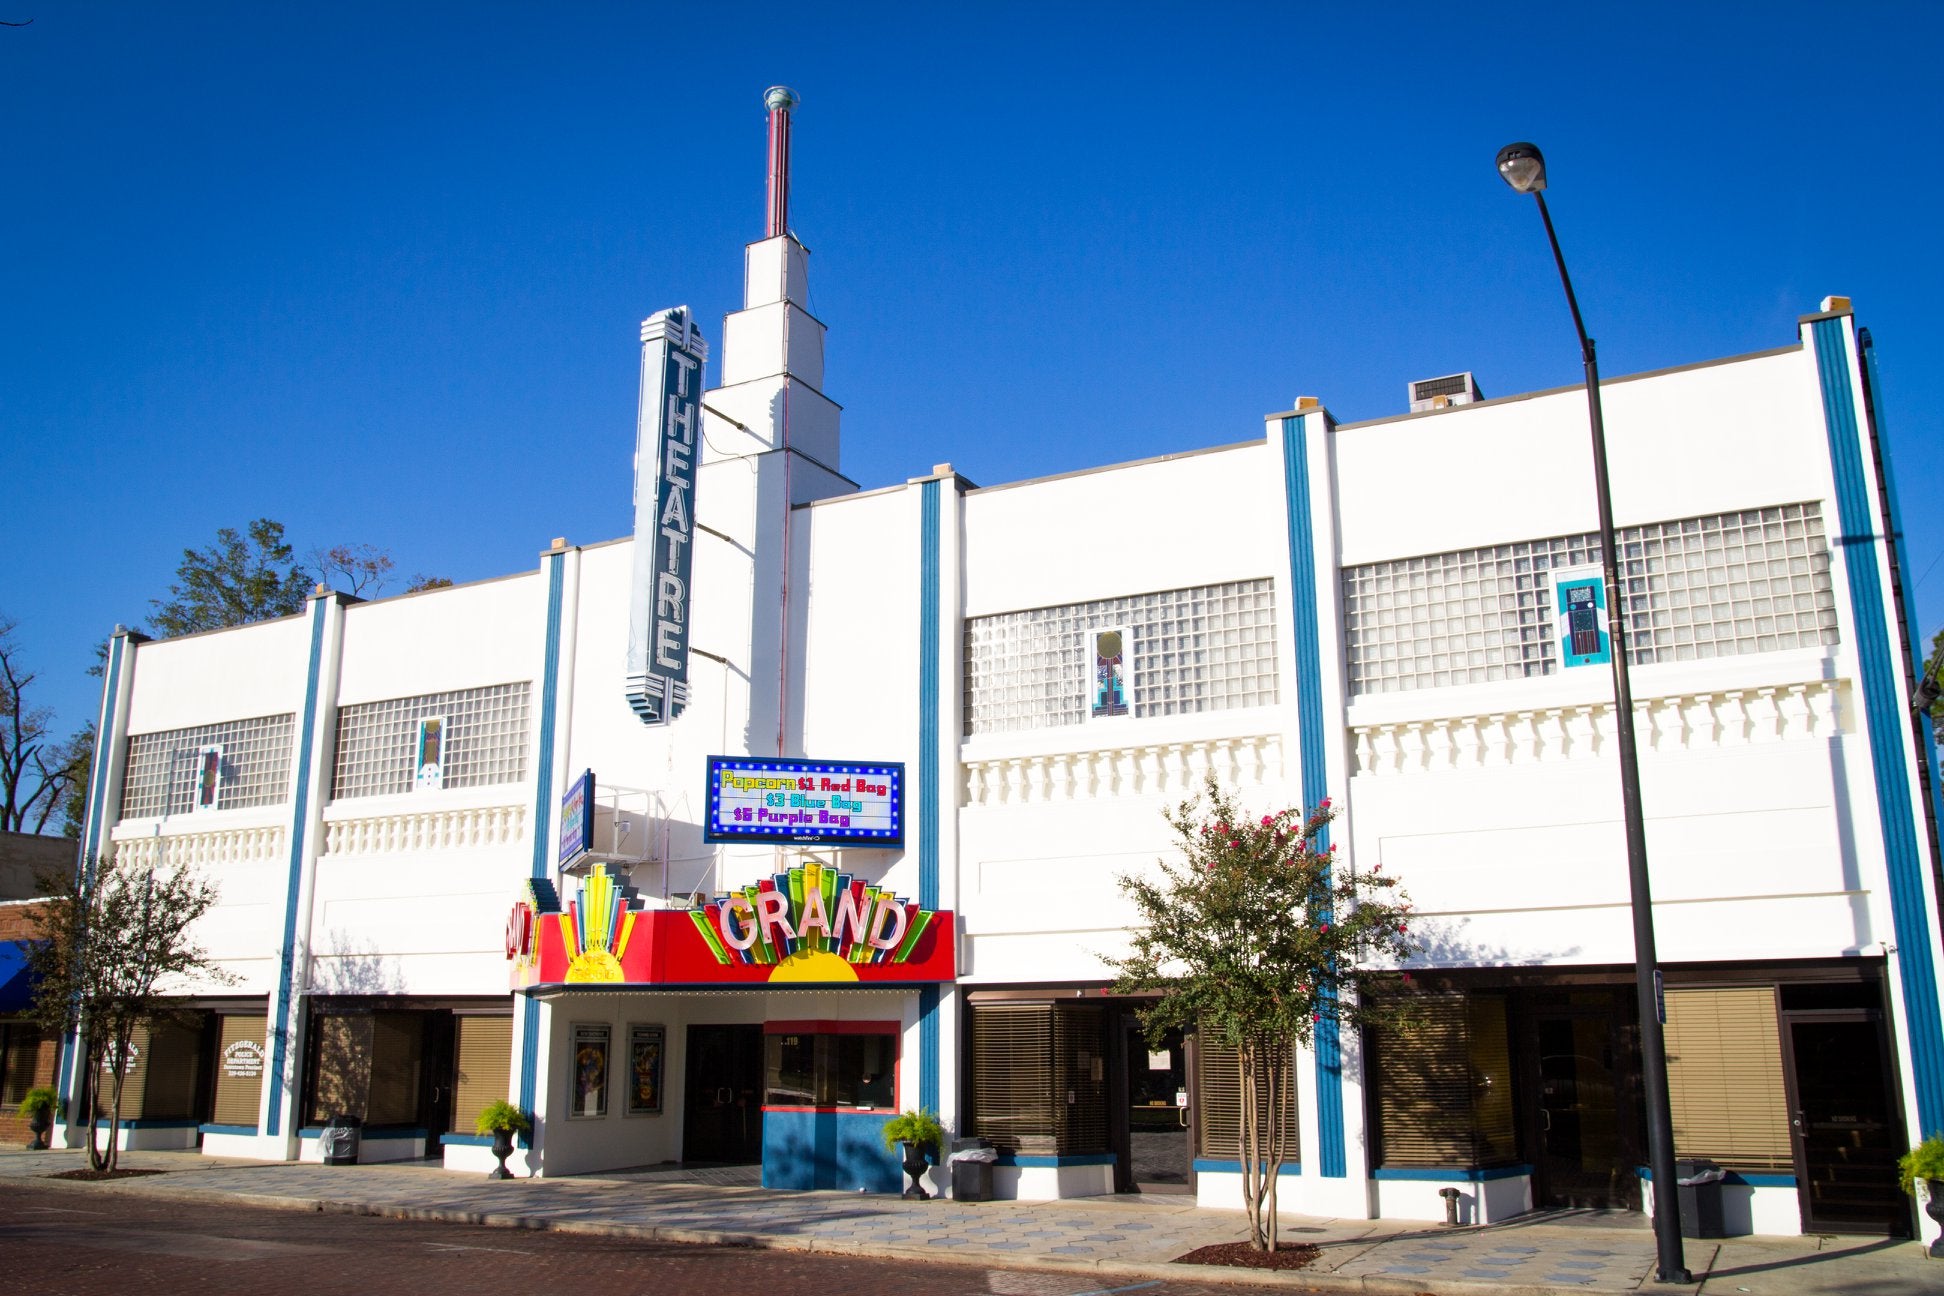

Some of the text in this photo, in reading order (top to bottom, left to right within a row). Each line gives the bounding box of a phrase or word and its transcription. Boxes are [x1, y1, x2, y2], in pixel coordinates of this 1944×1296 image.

[656, 350, 697, 670] THEATRE
[721, 770, 887, 796] Popcorn $1 Red Bag
[766, 792, 862, 813] $3 Blue Bag
[757, 808, 813, 826] Purple
[818, 810, 850, 827] Bag
[720, 887, 907, 950] GRAND
[224, 1040, 264, 1058] FITZGERALD
